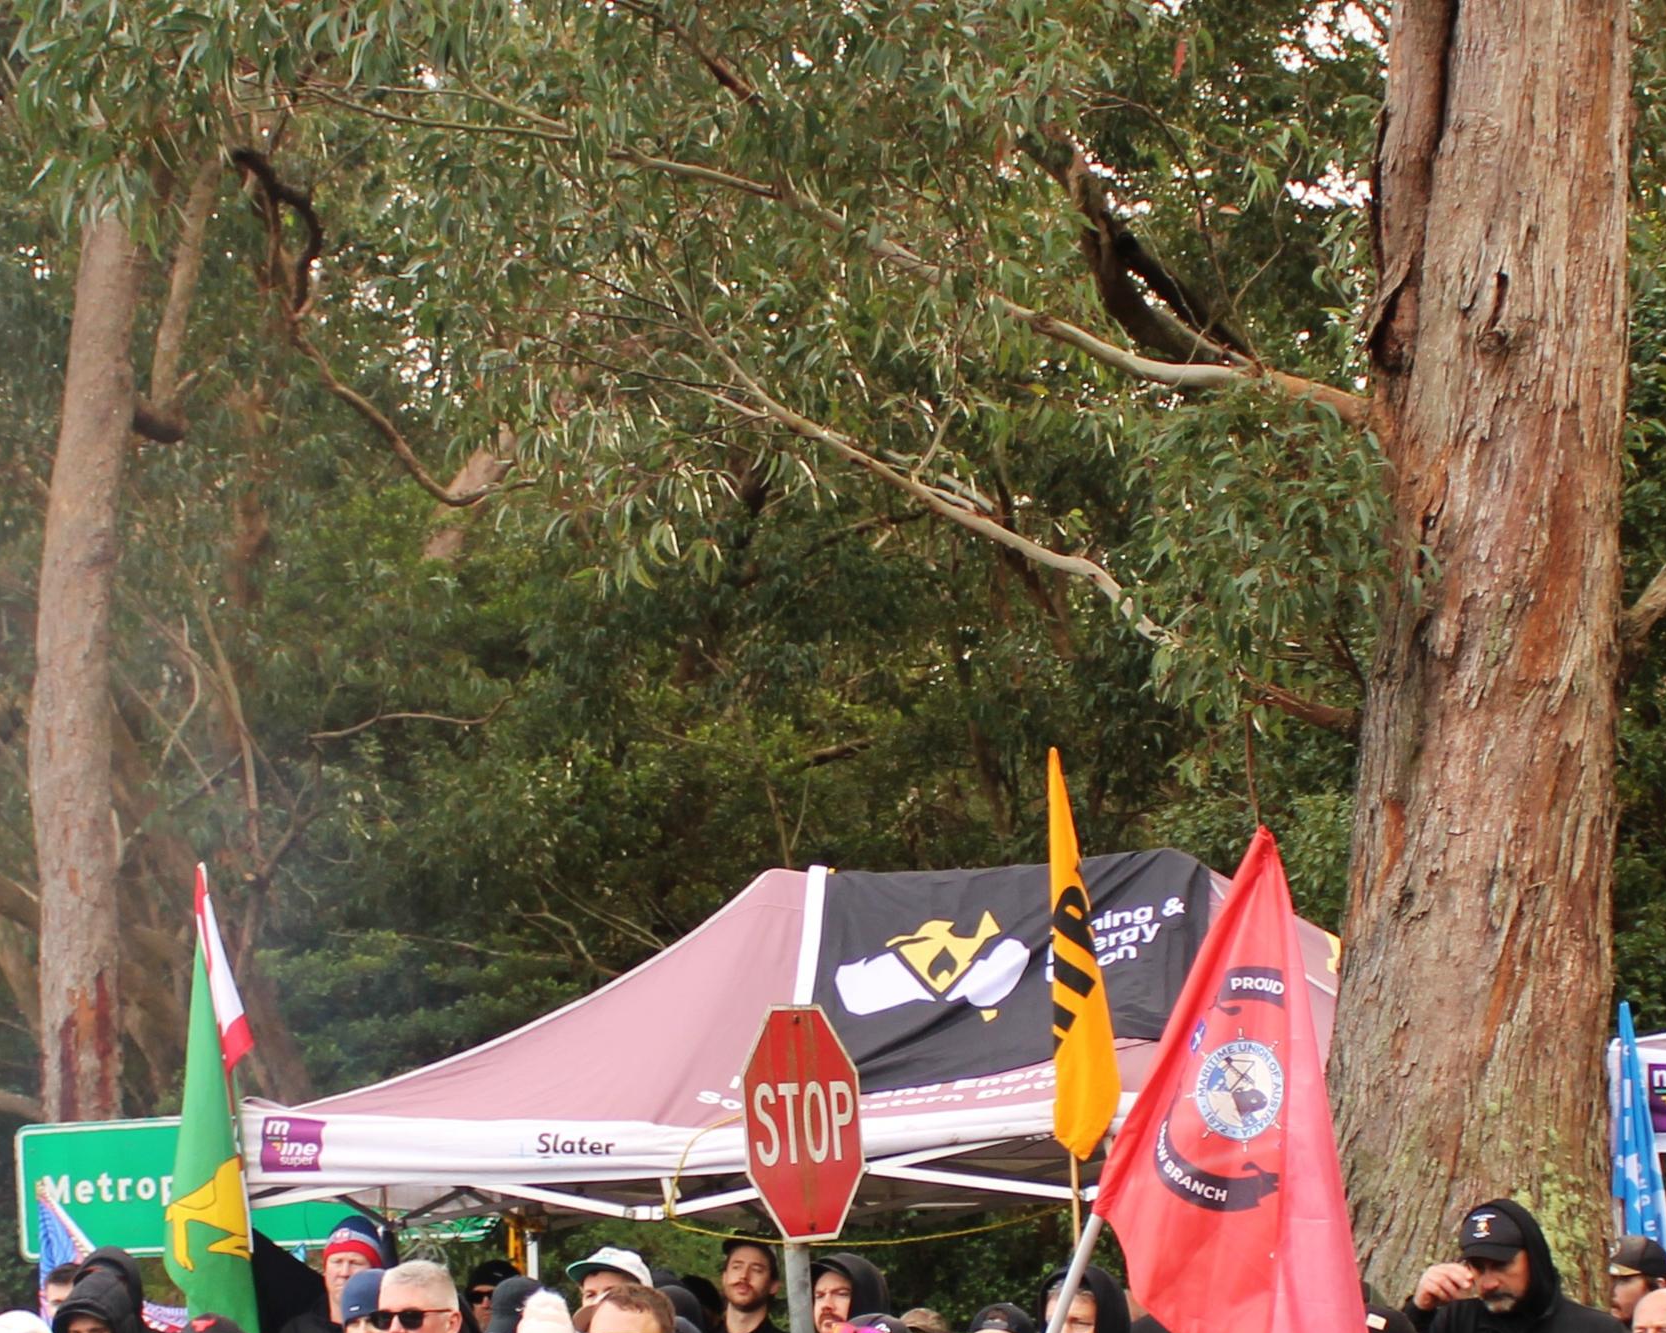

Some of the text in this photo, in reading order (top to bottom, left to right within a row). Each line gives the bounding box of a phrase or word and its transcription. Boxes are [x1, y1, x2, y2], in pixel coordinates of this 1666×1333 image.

[1090, 896, 1186, 932] ning &
[1092, 922, 1161, 953] ergy
[1230, 976, 1285, 996] PROUD
[1238, 1043, 1272, 1063] UNION
[869, 1064, 1057, 1100] and Energ
[1197, 1044, 1237, 1098] MARITIME
[753, 1080, 855, 1168] STOP
[1204, 1111, 1229, 1135] 1872
[1241, 1083, 1283, 1137] AUSTRALIA
[279, 1154, 316, 1168] super
[536, 1132, 616, 1157] Slater
[1163, 1159, 1229, 1203] BRANCH
